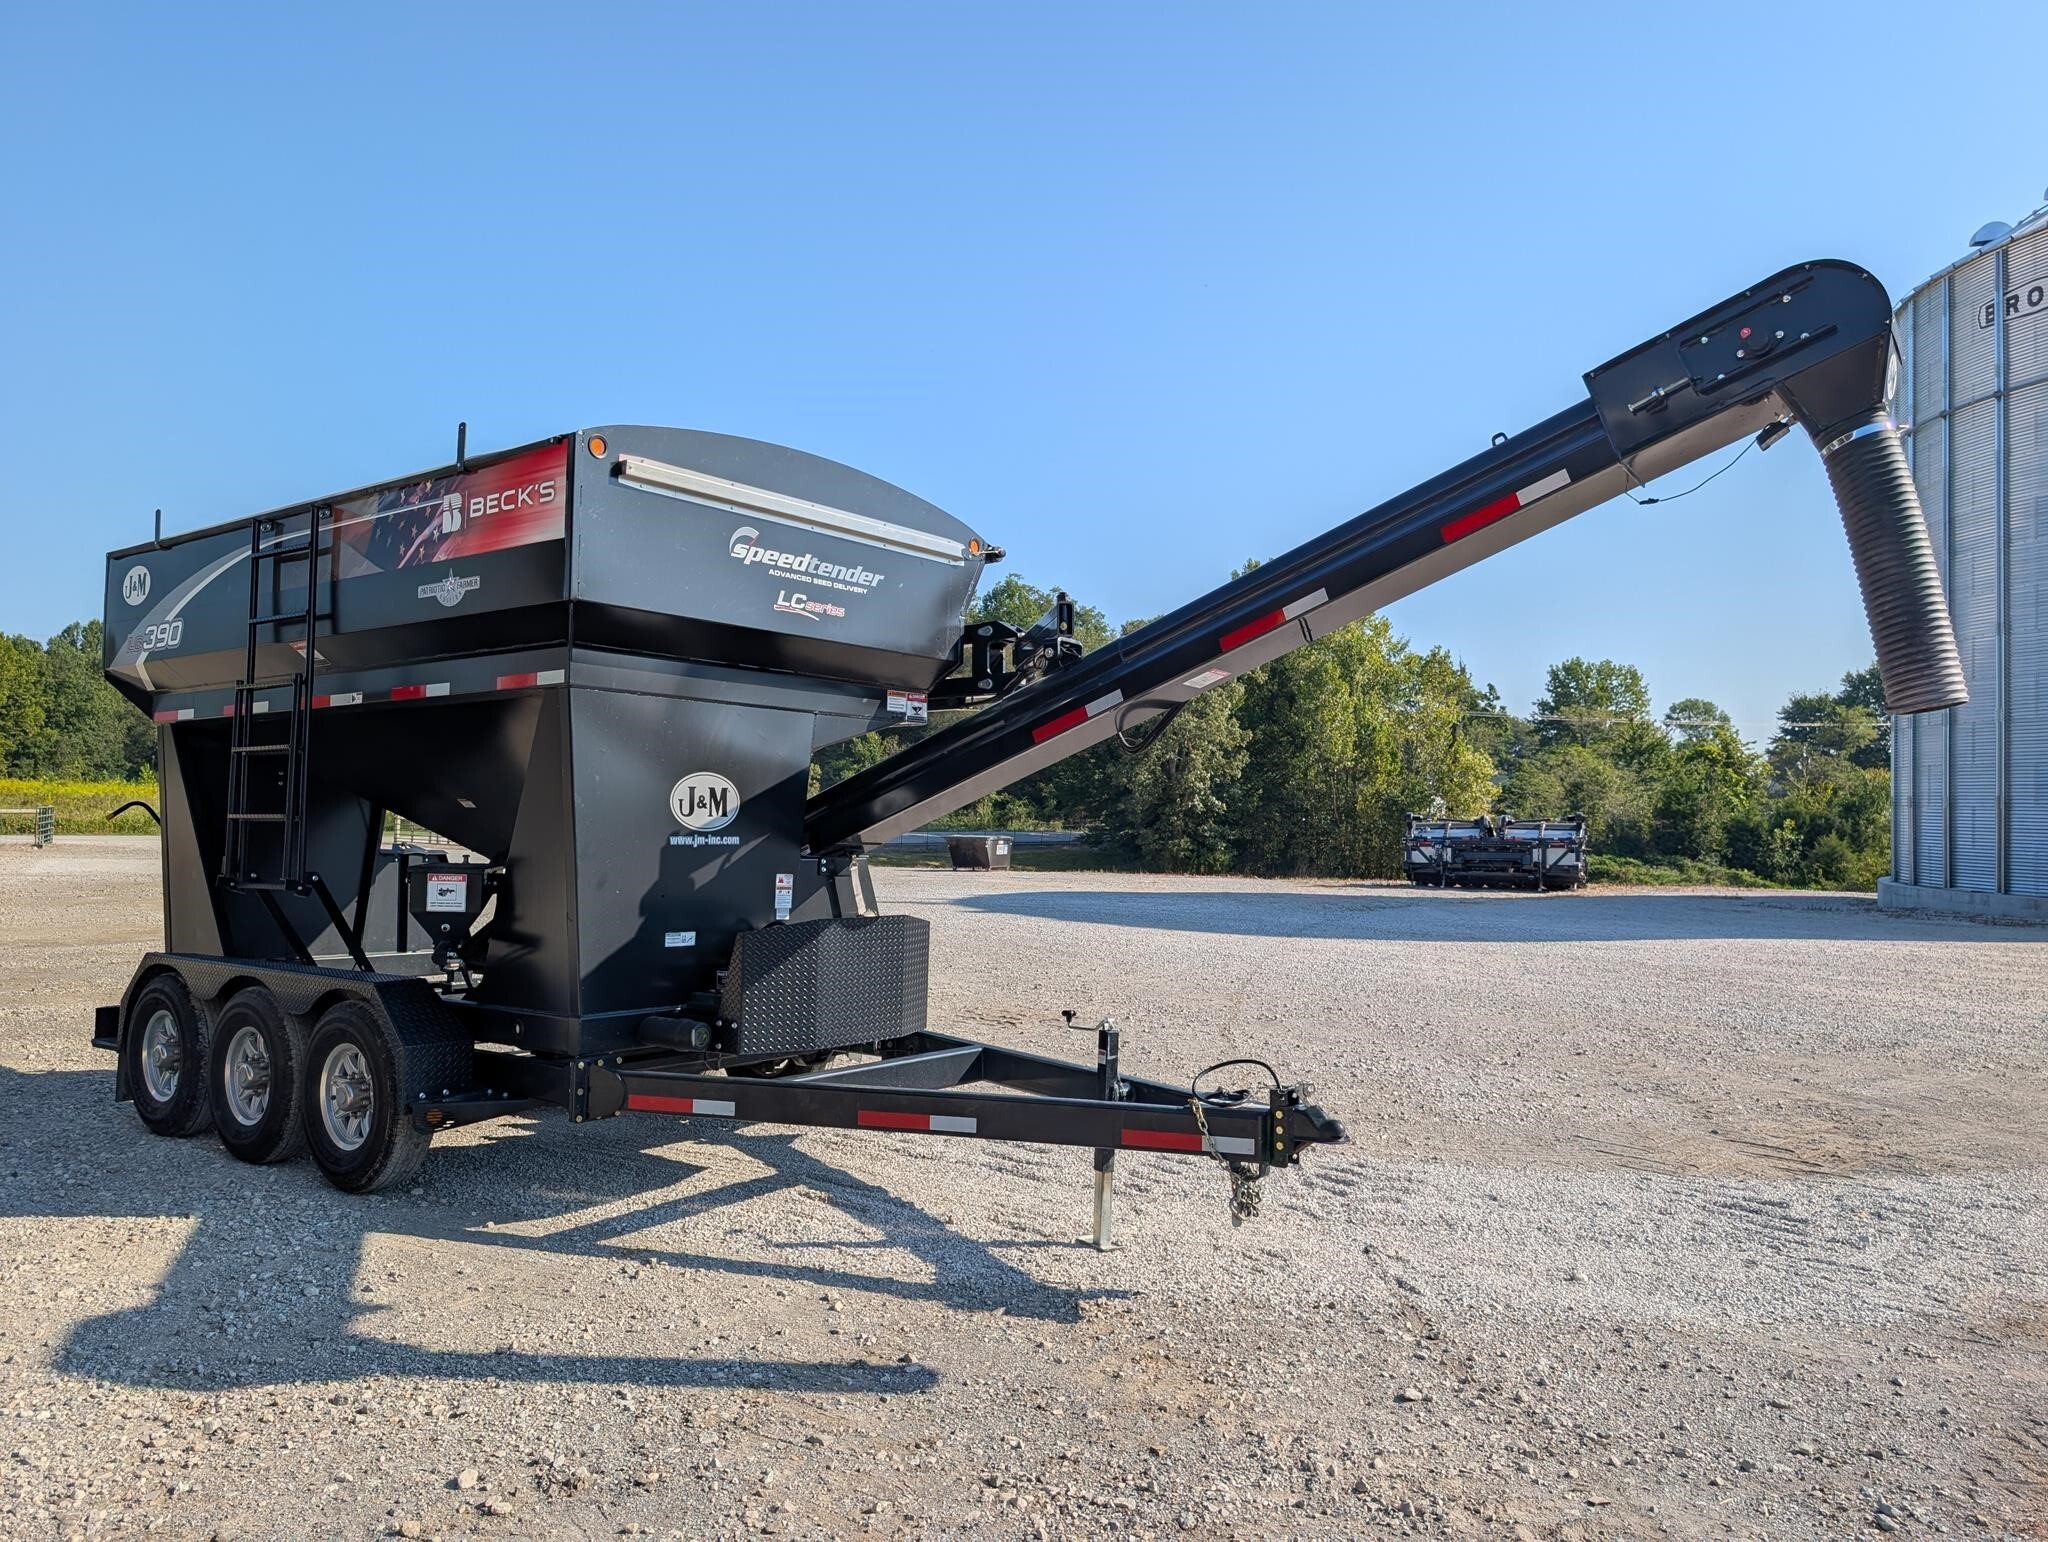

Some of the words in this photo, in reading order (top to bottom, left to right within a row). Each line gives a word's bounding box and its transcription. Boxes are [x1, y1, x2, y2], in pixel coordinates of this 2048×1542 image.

[469, 480, 556, 519] BECK'S
[125, 572, 148, 599] J&M
[456, 578, 479, 590] FARMER
[768, 568, 812, 584] ADVANCED
[812, 577, 833, 588] SEED
[833, 582, 868, 595] DELIVERY
[678, 786, 729, 818] J&M
[669, 833, 740, 848] www.jm-inc.com
